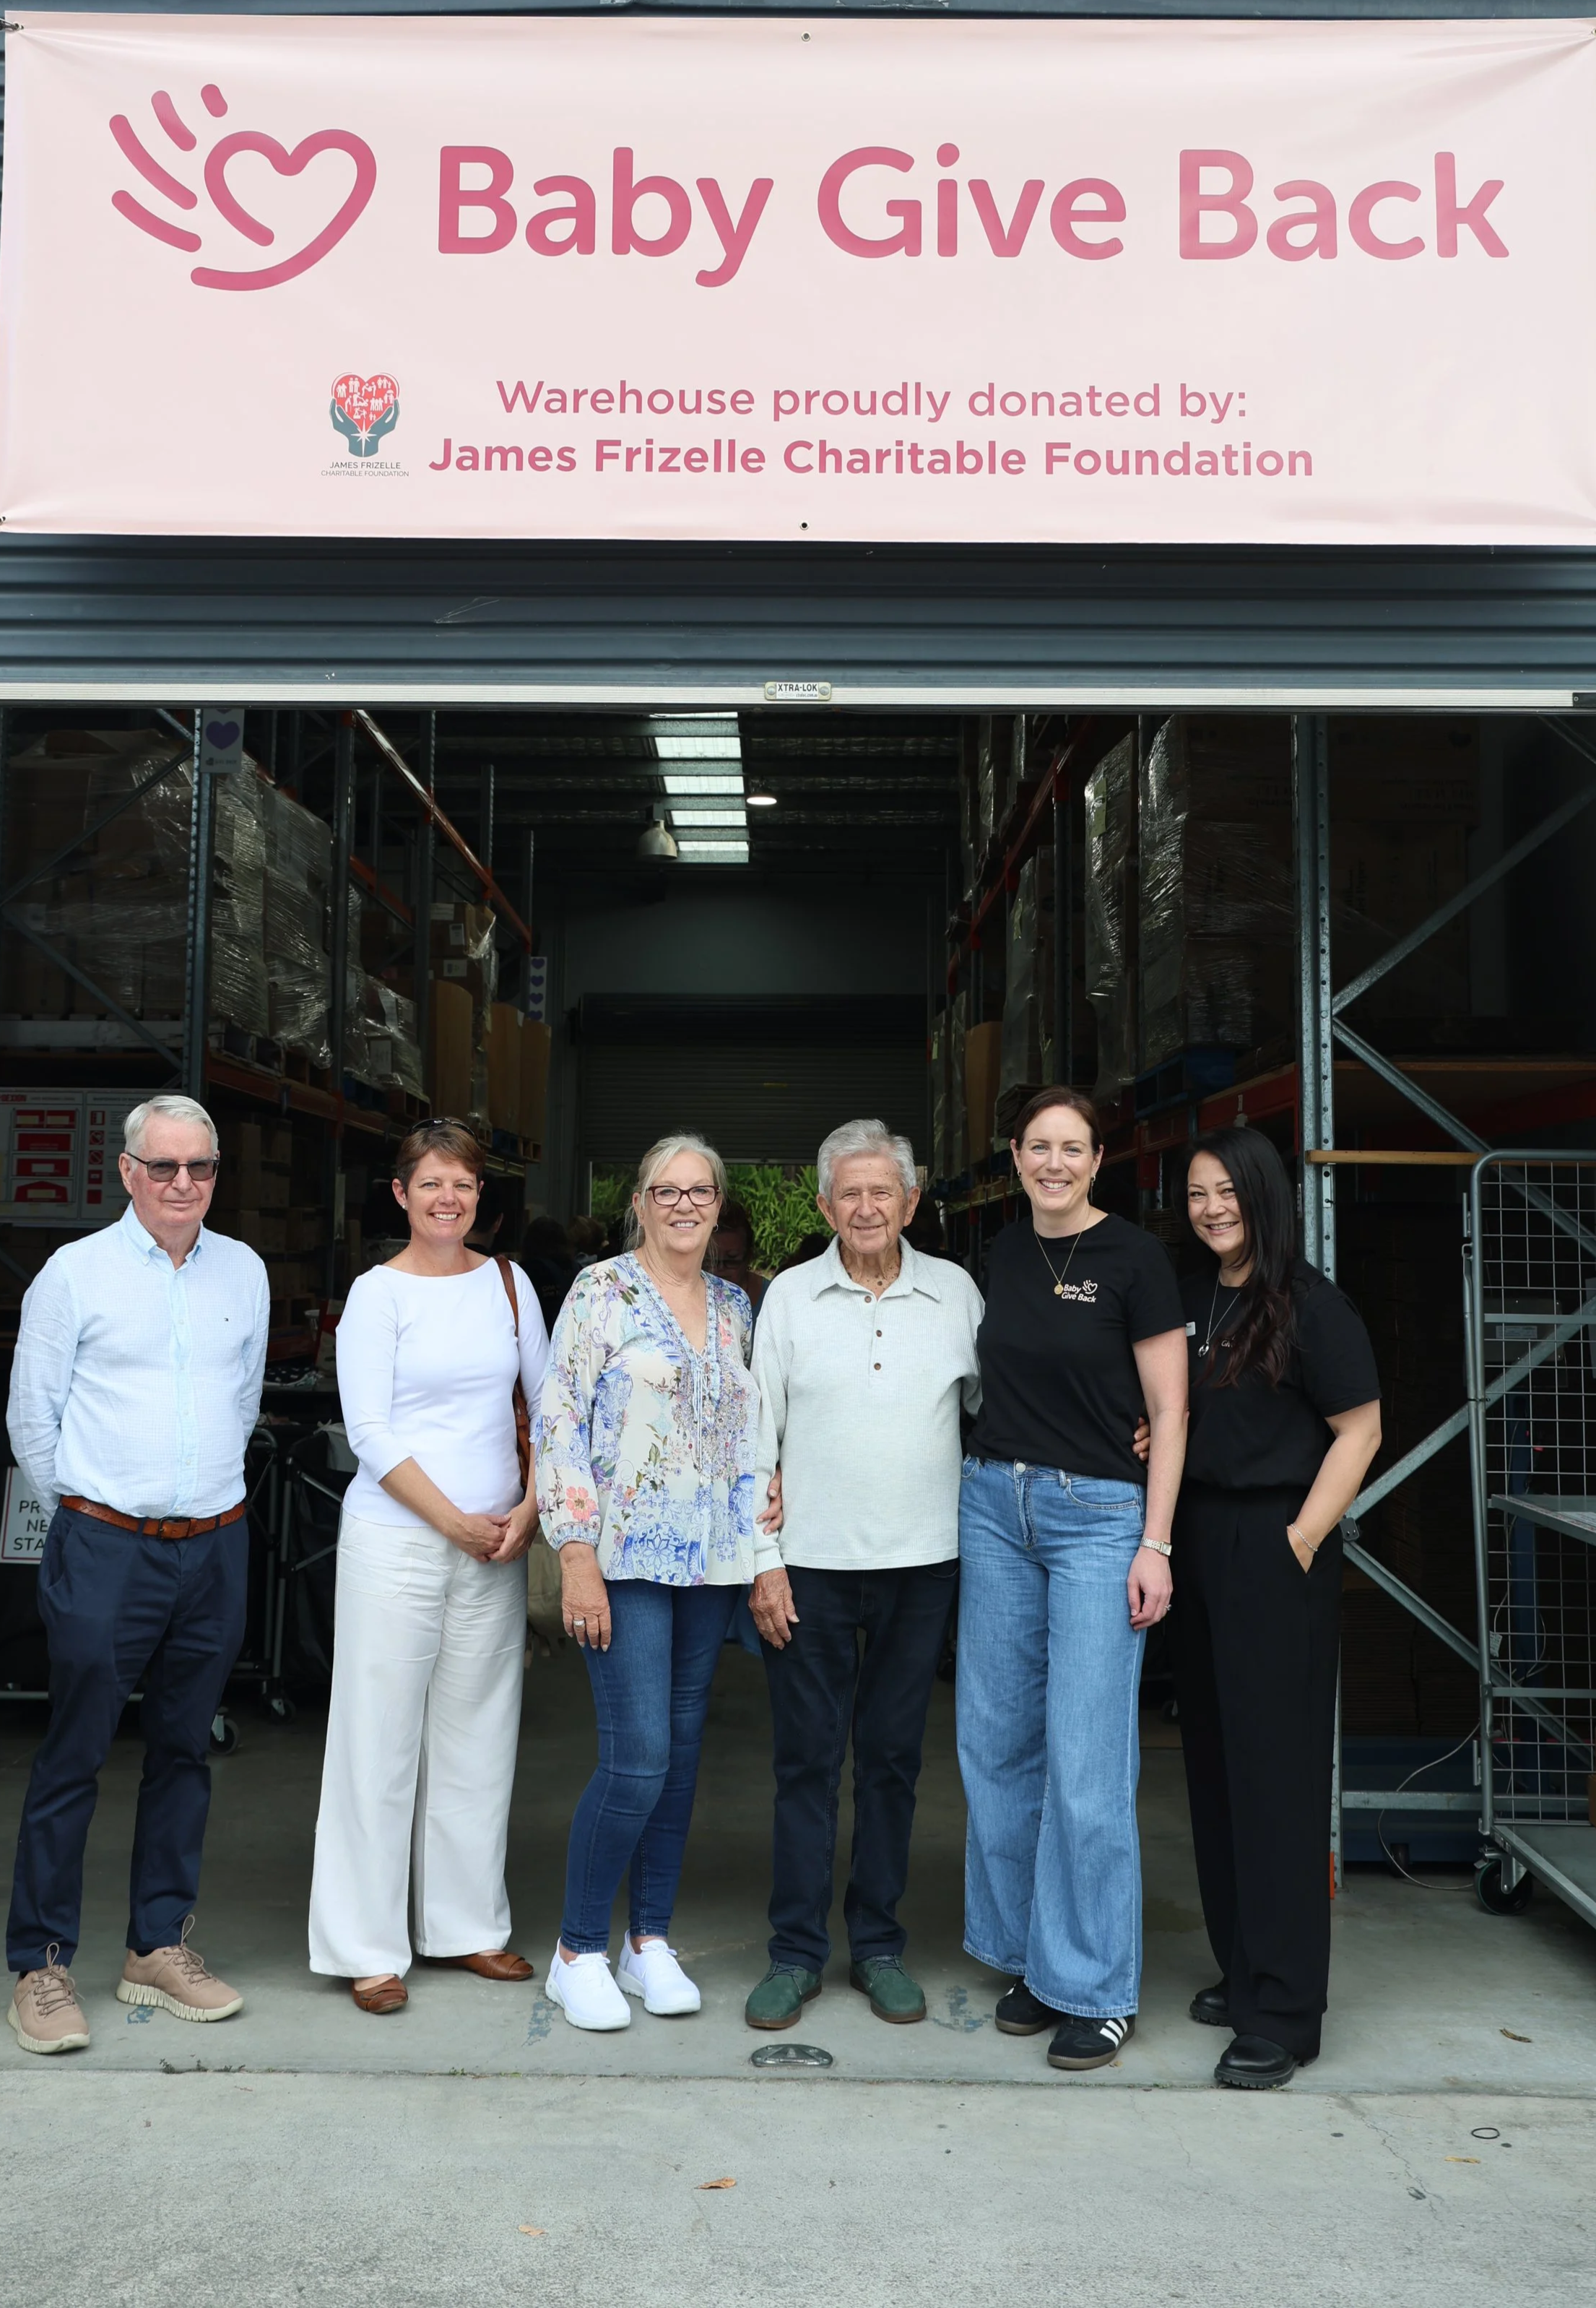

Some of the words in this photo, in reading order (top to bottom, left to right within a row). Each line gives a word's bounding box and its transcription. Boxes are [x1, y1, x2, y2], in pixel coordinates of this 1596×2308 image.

[438, 145, 774, 288] Baby
[817, 143, 1127, 260] Give
[1179, 150, 1509, 262] Back
[496, 380, 755, 415] Warehouse
[773, 382, 950, 423] proudly
[968, 382, 1160, 417] donated
[1180, 384, 1246, 424] by:
[429, 438, 576, 472] James
[595, 438, 766, 473] Frizelle
[784, 439, 1026, 475] Charitable
[1045, 441, 1312, 477] Foundation
[1063, 1284, 1082, 1294] Baby
[1077, 1293, 1096, 1302] Back
[19, 1500, 40, 1514] PR
[26, 1518, 48, 1533] NE
[13, 1536, 45, 1552] STA
